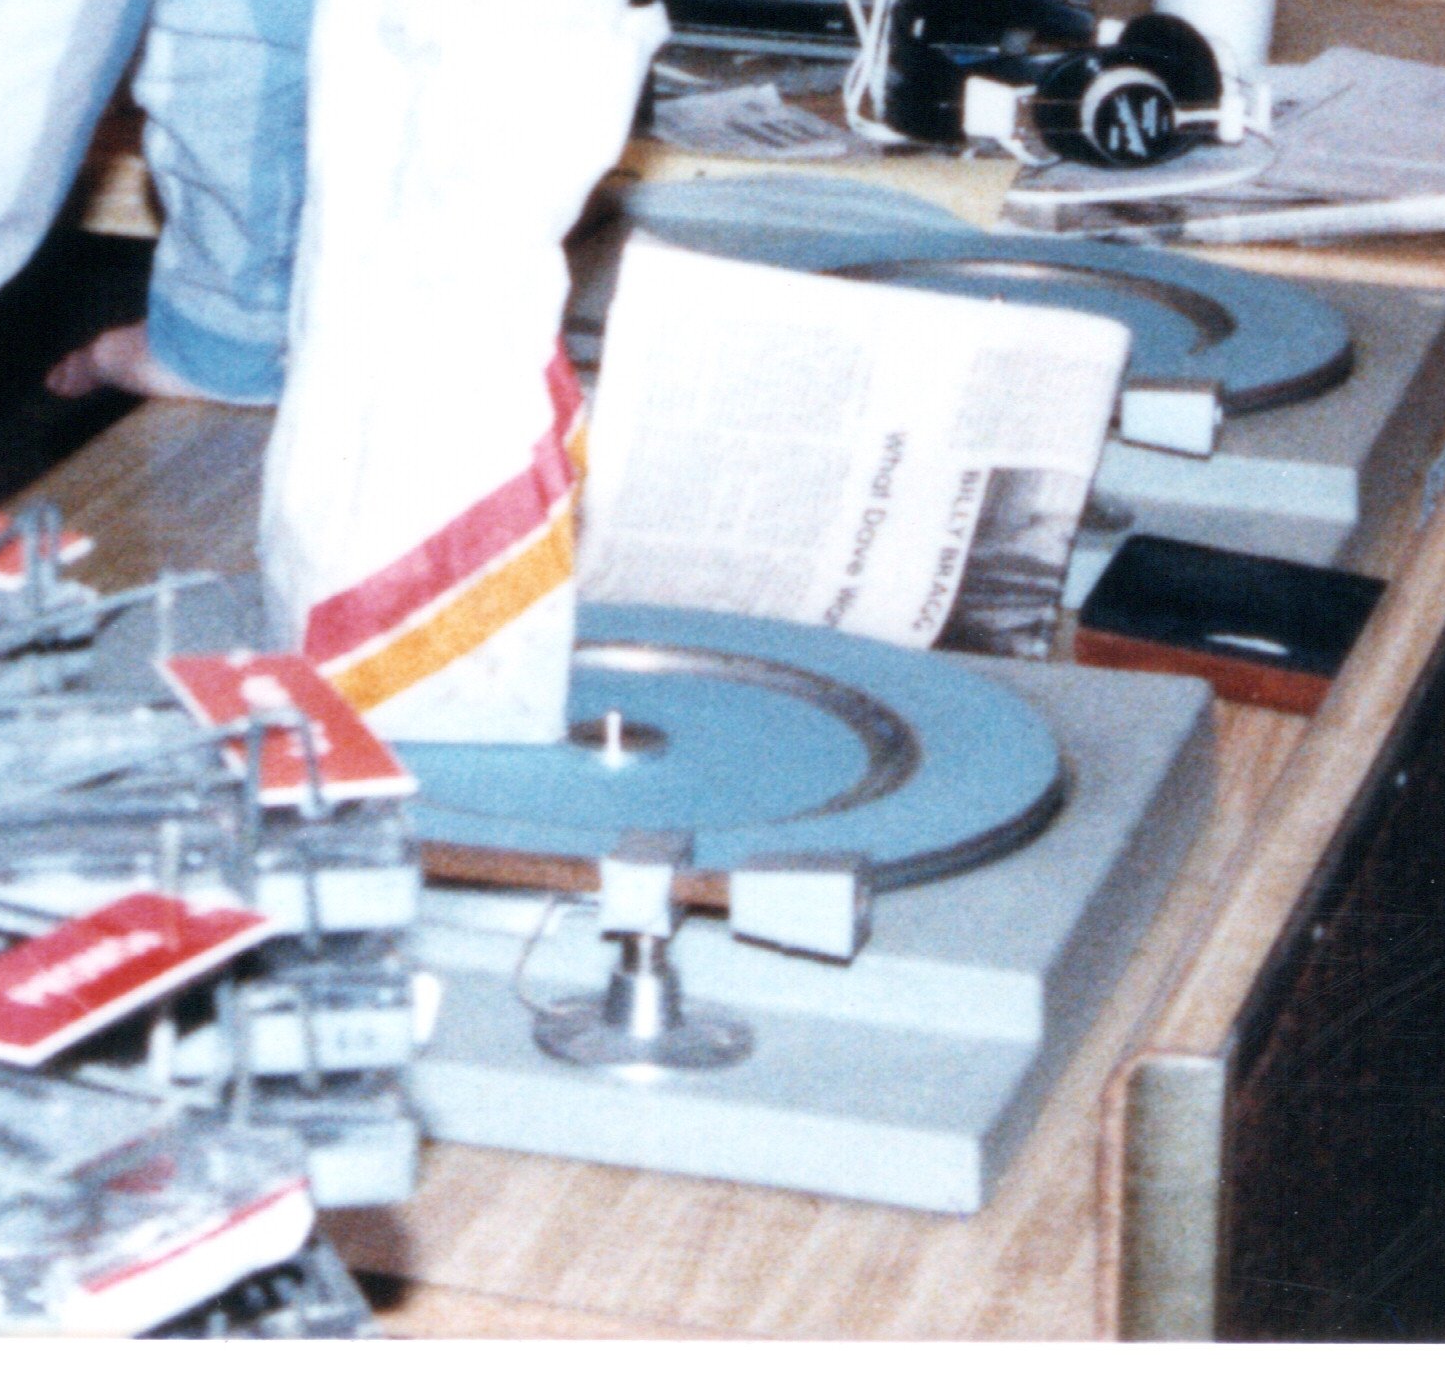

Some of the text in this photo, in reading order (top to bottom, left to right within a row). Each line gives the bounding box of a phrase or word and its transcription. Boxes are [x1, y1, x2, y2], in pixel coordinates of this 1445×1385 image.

[870, 431, 907, 500] What
[948, 467, 981, 539] BILLY
[845, 507, 888, 578] Dave
